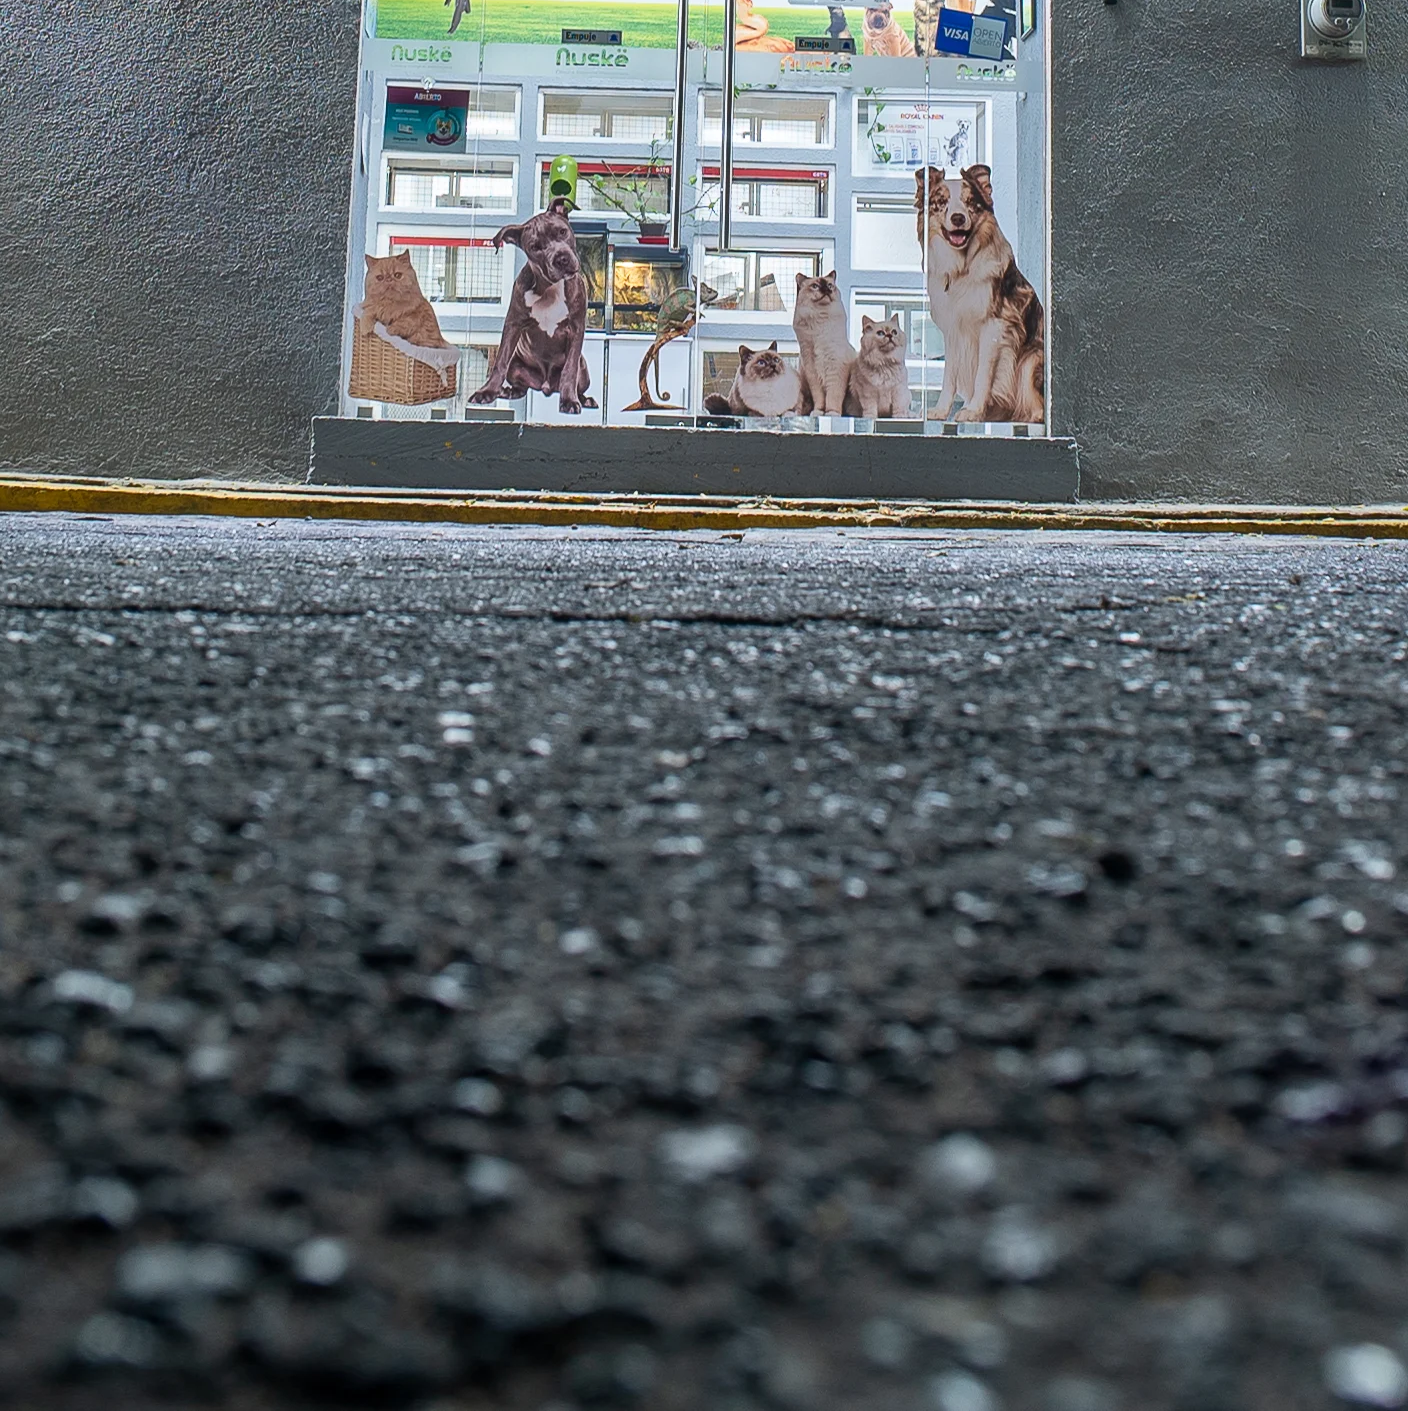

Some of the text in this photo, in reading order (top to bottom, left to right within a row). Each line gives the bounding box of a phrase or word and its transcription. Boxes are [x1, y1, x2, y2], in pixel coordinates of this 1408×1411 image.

[943, 26, 1003, 42] VISA OPEN
[972, 37, 1002, 49] ABIERTO
